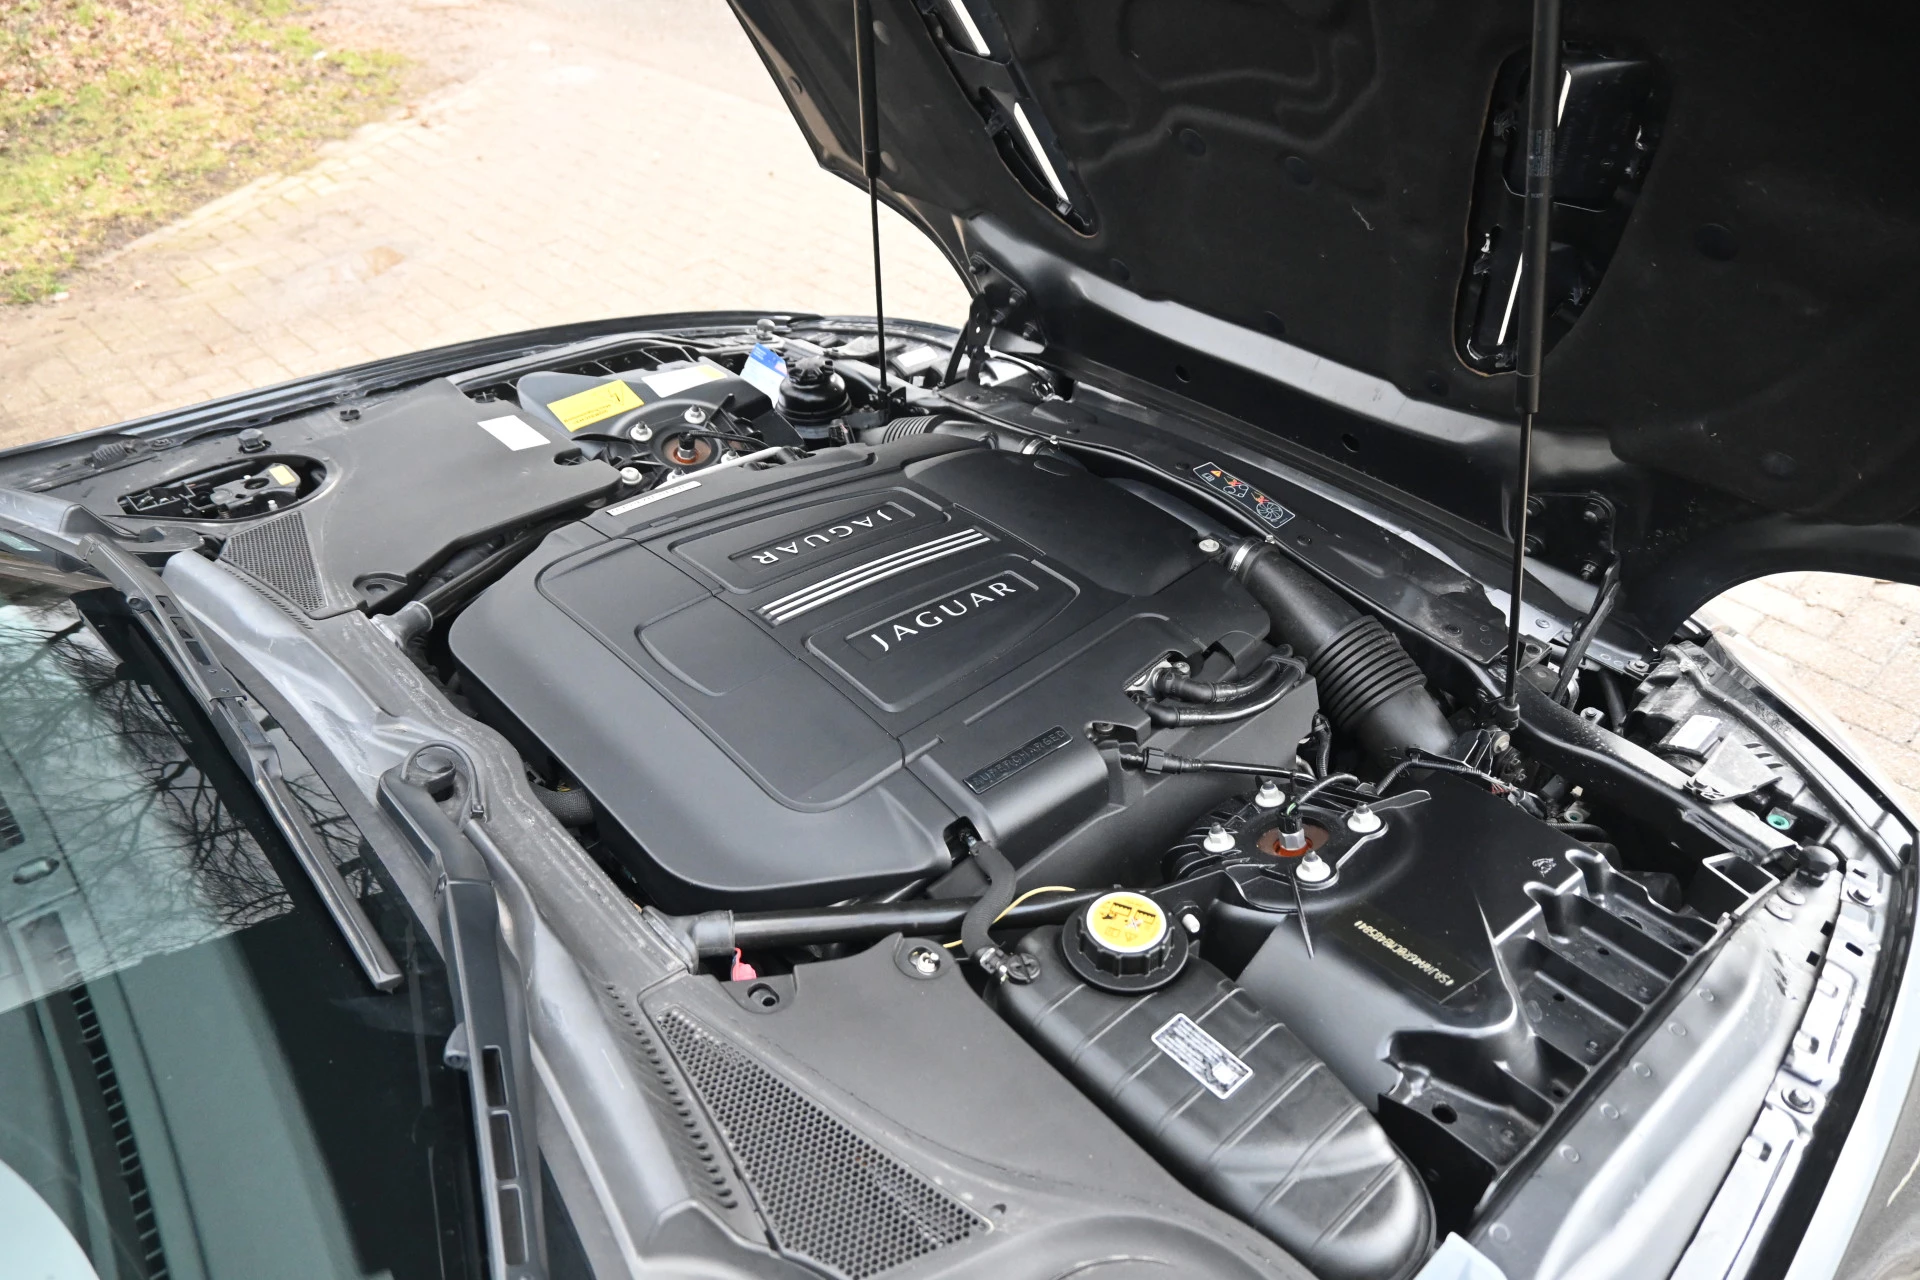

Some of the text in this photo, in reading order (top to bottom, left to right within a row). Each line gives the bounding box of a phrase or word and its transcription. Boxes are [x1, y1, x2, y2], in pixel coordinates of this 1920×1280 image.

[751, 509, 894, 565] JAGUAR
[871, 581, 1017, 652] JAGUAR
[973, 729, 1067, 786] SUPERCHARGED
